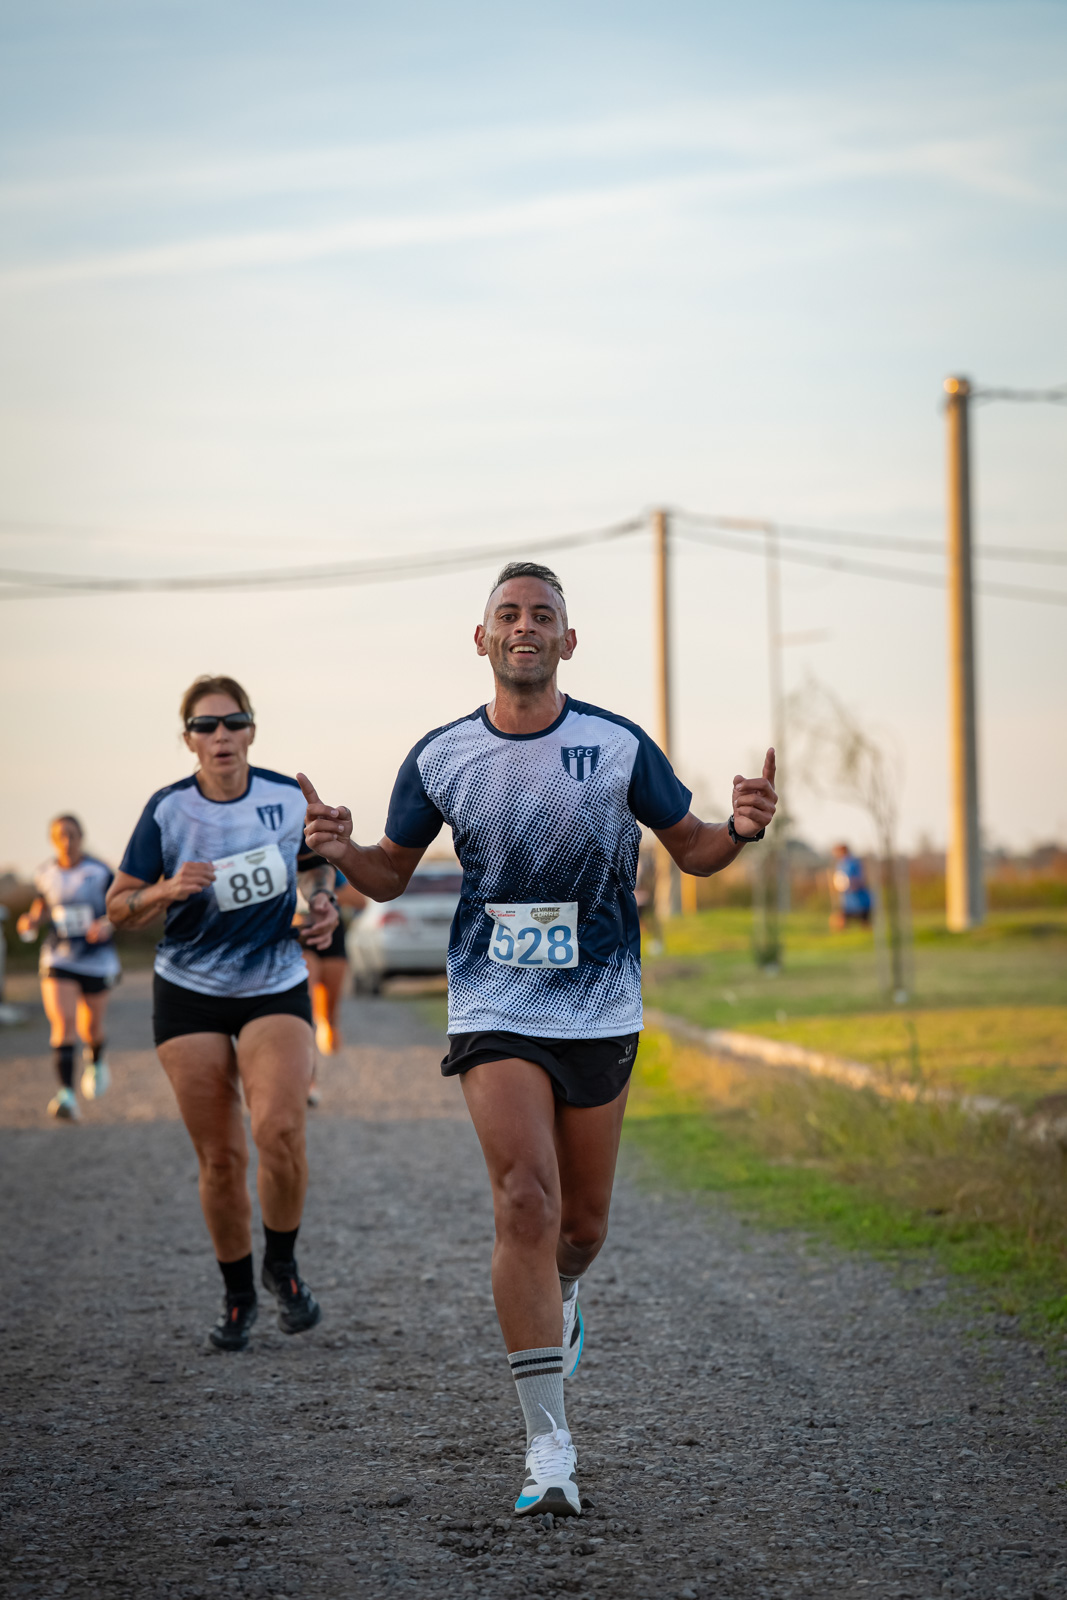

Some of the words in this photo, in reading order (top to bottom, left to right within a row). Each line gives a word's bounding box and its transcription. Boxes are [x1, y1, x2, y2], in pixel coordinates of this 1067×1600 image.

[568, 749, 593, 758] SFC
[229, 867, 274, 904] 89
[493, 925, 574, 965] 528
